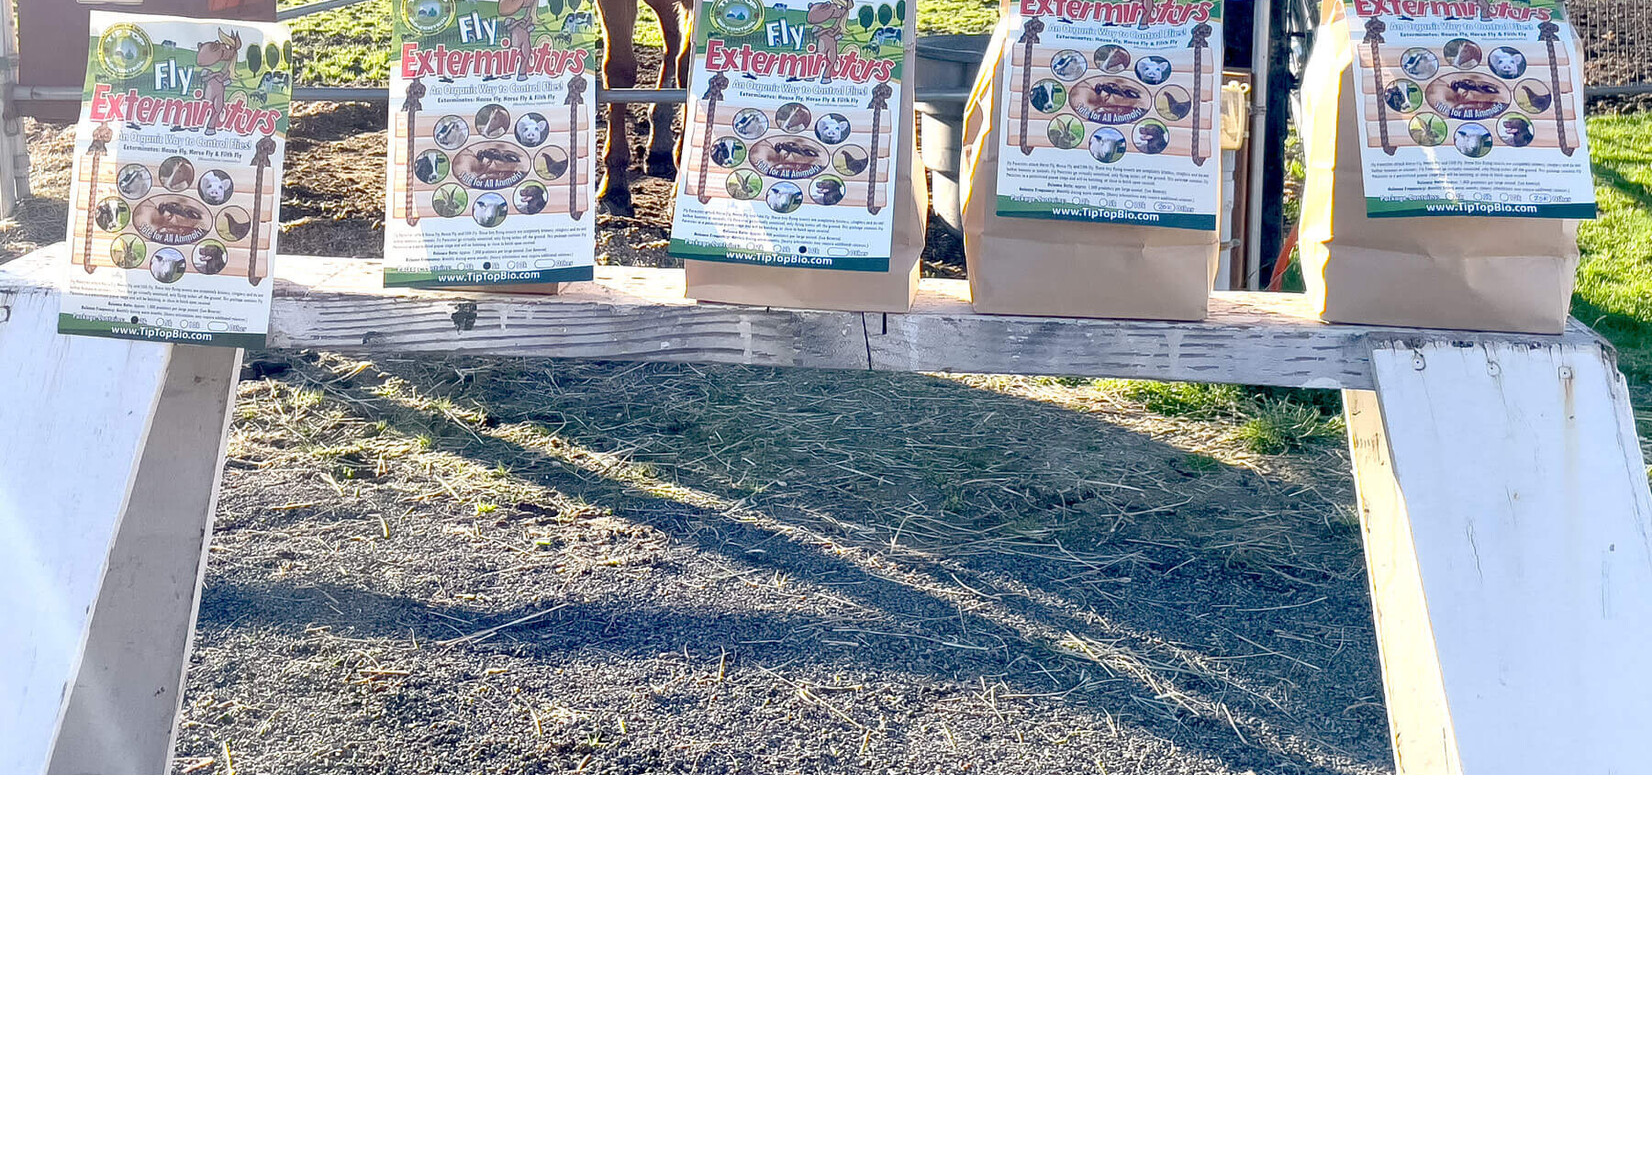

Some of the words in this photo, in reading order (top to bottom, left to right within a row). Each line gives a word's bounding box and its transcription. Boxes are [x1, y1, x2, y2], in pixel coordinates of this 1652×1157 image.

[457, 10, 498, 45] Fly
[765, 17, 805, 50] Fly
[154, 58, 194, 96] Fly
[430, 85, 441, 94] An
[443, 84, 477, 98] Organic
[478, 84, 497, 97] Way
[510, 83, 540, 93] Control
[732, 79, 745, 88] An
[746, 80, 780, 92] Organic
[781, 84, 800, 94] Way
[813, 85, 845, 95] Control
[1090, 110, 1100, 119] for
[1102, 113, 1111, 122] All
[1113, 107, 1142, 122] Animals!
[1463, 109, 1473, 118] All
[130, 132, 163, 147] Organic
[165, 134, 183, 148] Way
[195, 137, 228, 148] Control
[473, 178, 485, 186] for
[485, 179, 493, 187] All
[495, 170, 523, 187] Animals!
[769, 166, 780, 175] for
[781, 169, 790, 177] All
[791, 164, 820, 178] Animals!
[1052, 207, 1159, 222] www.TipTopBio.com
[1426, 202, 1537, 215] www.TipTopBio.com
[152, 230, 163, 240] for
[164, 234, 173, 242] All
[174, 227, 203, 243] Animals!
[725, 251, 833, 266] www.TipTopBio.com
[438, 271, 540, 283] www.TipTopBio.com
[111, 326, 212, 341] www.TipTopBio.com
